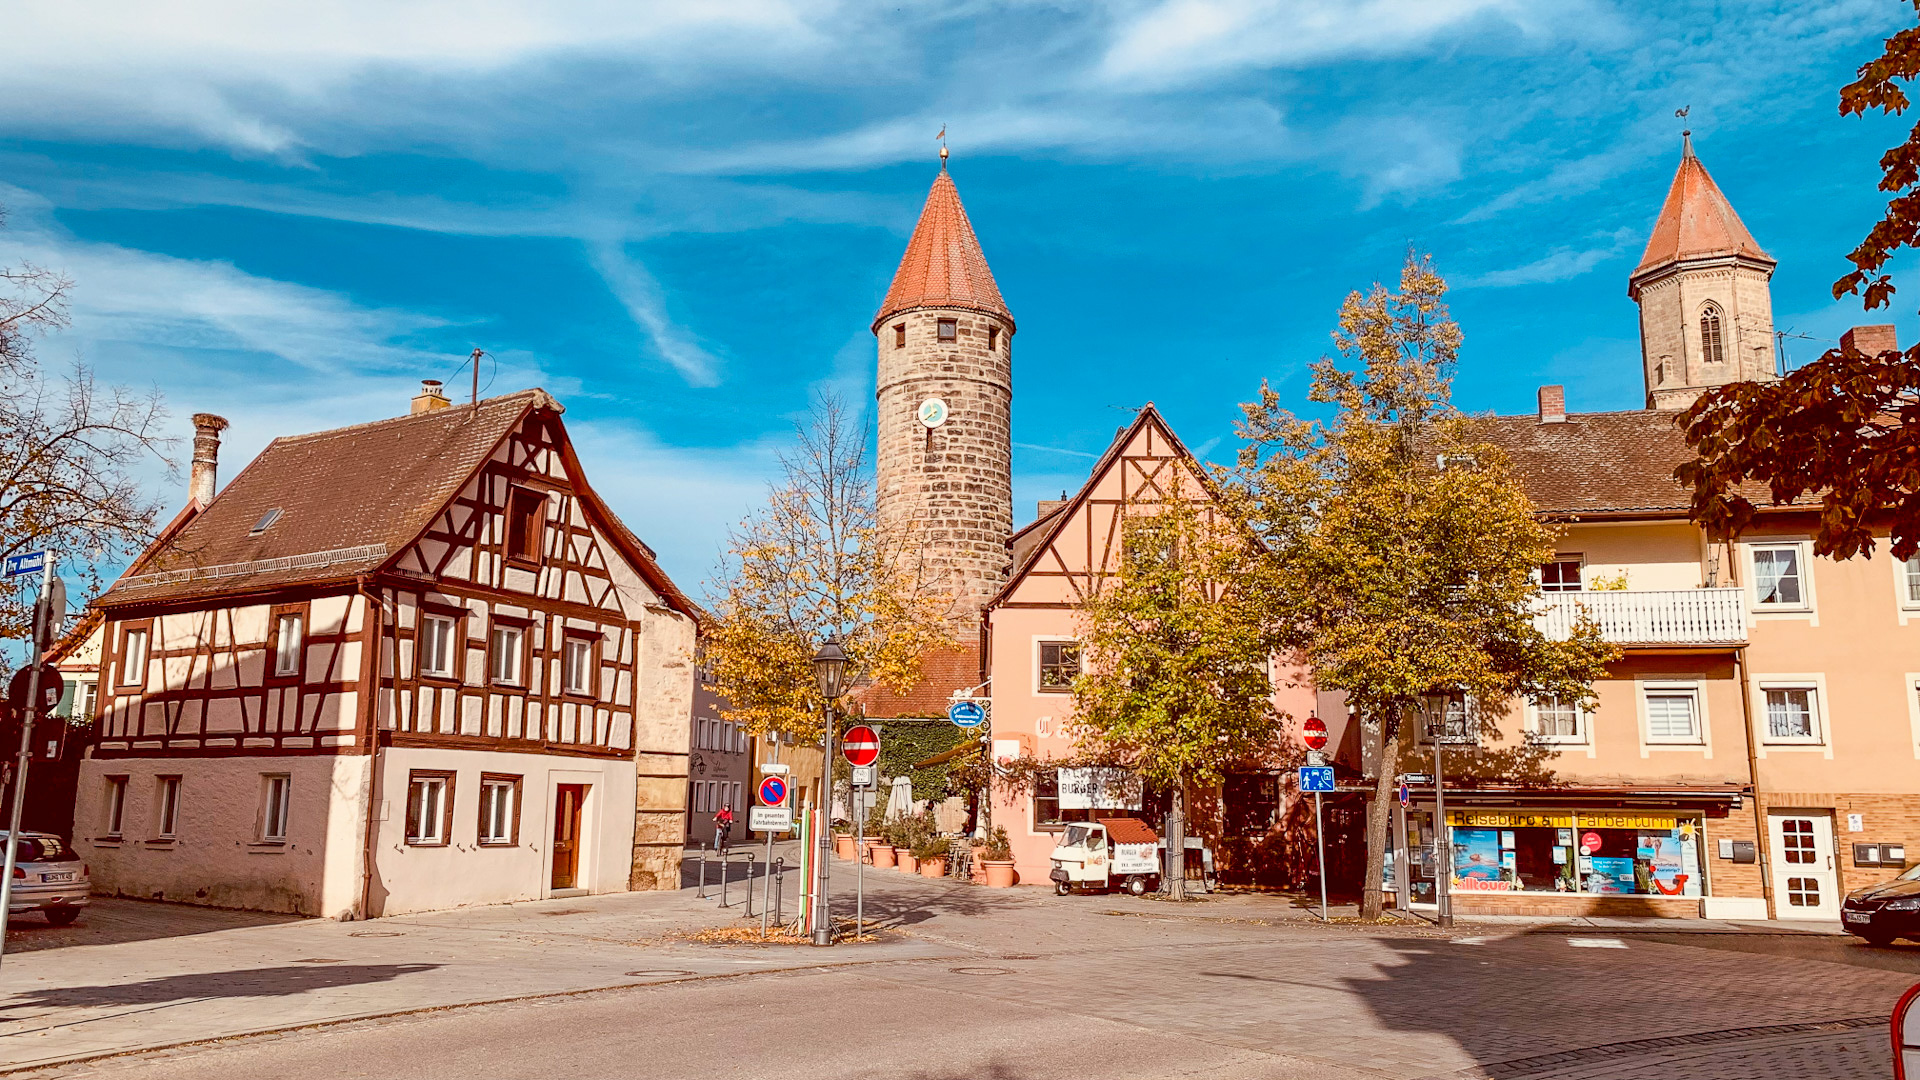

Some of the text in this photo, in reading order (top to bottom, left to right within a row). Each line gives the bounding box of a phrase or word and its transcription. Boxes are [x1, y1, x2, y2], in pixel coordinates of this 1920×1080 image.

[19, 554, 43, 570] Altmühl
[1061, 783, 1098, 794] BURGER
[1454, 810, 1677, 828] Reisebüro am Färberturm
[1456, 876, 1511, 891] alltours
